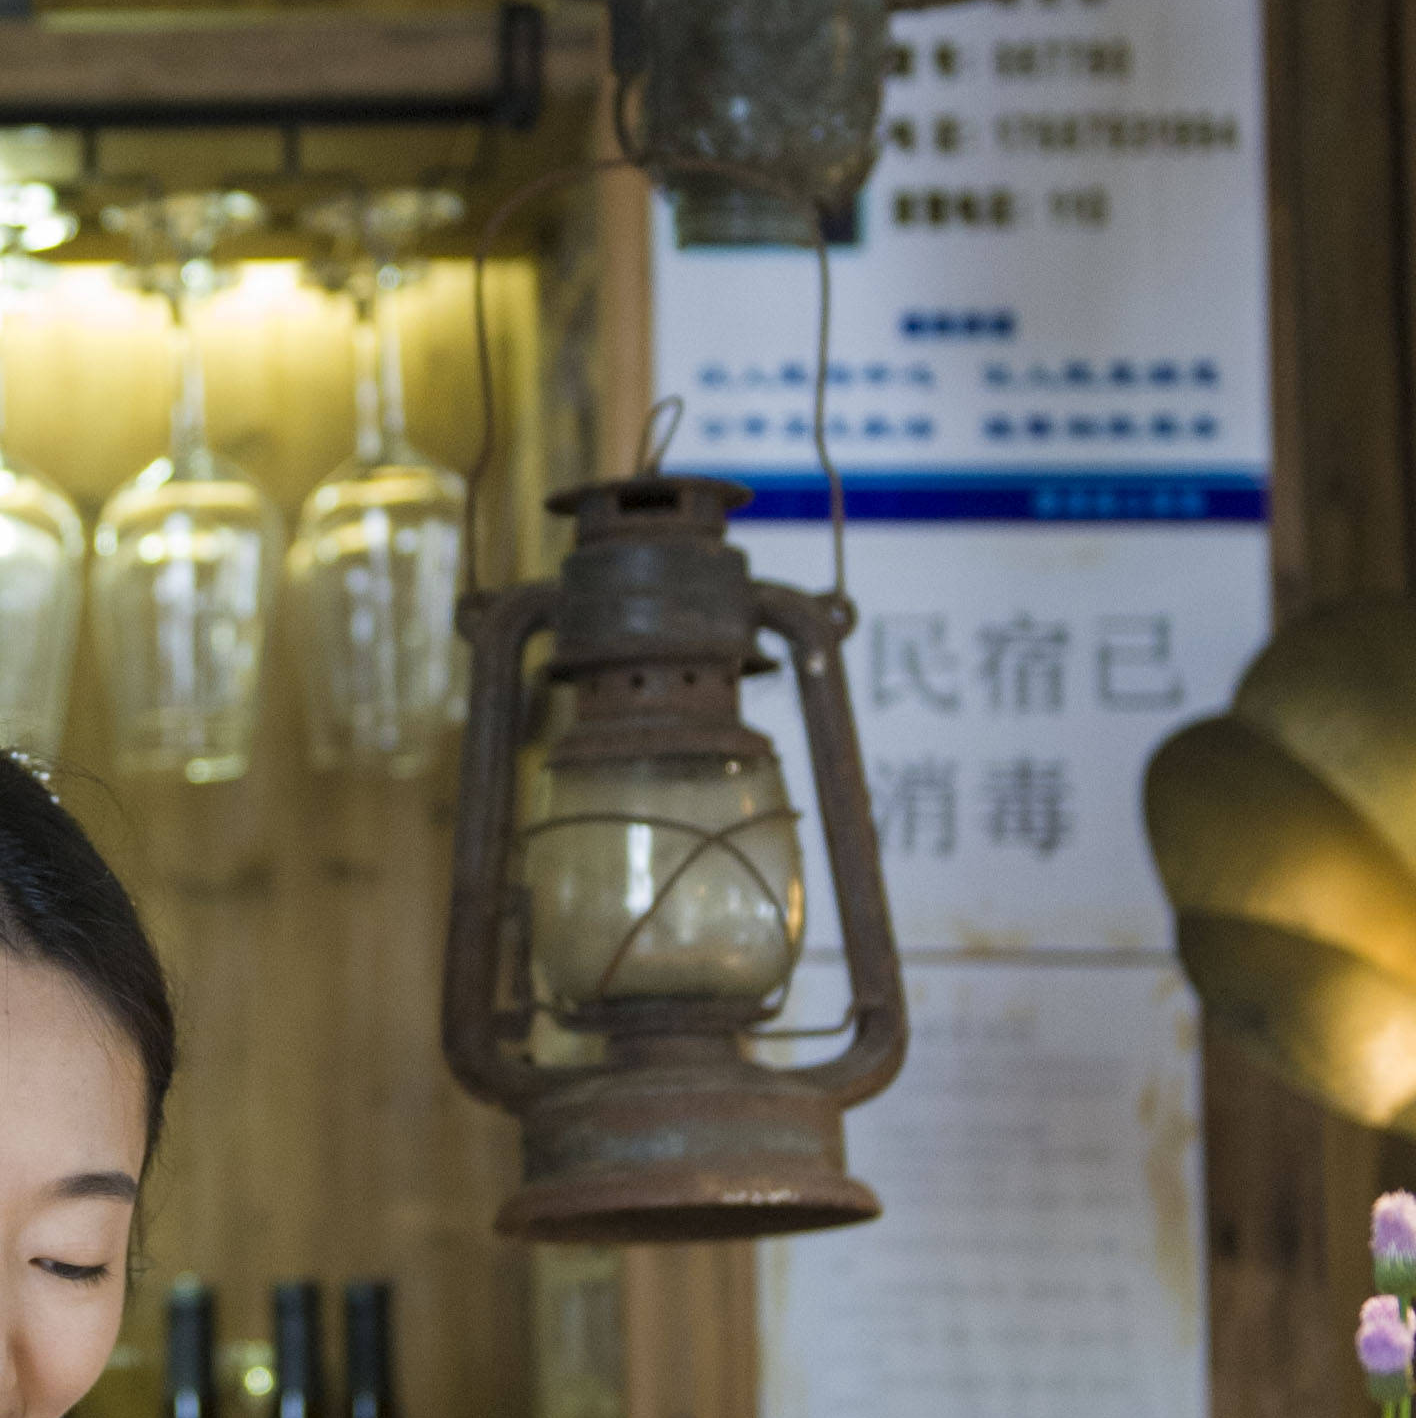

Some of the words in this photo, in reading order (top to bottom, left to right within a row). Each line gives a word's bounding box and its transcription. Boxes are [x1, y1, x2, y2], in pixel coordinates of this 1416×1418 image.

[868, 609, 1186, 715] 民宿已
[874, 753, 1076, 859] 消毒
